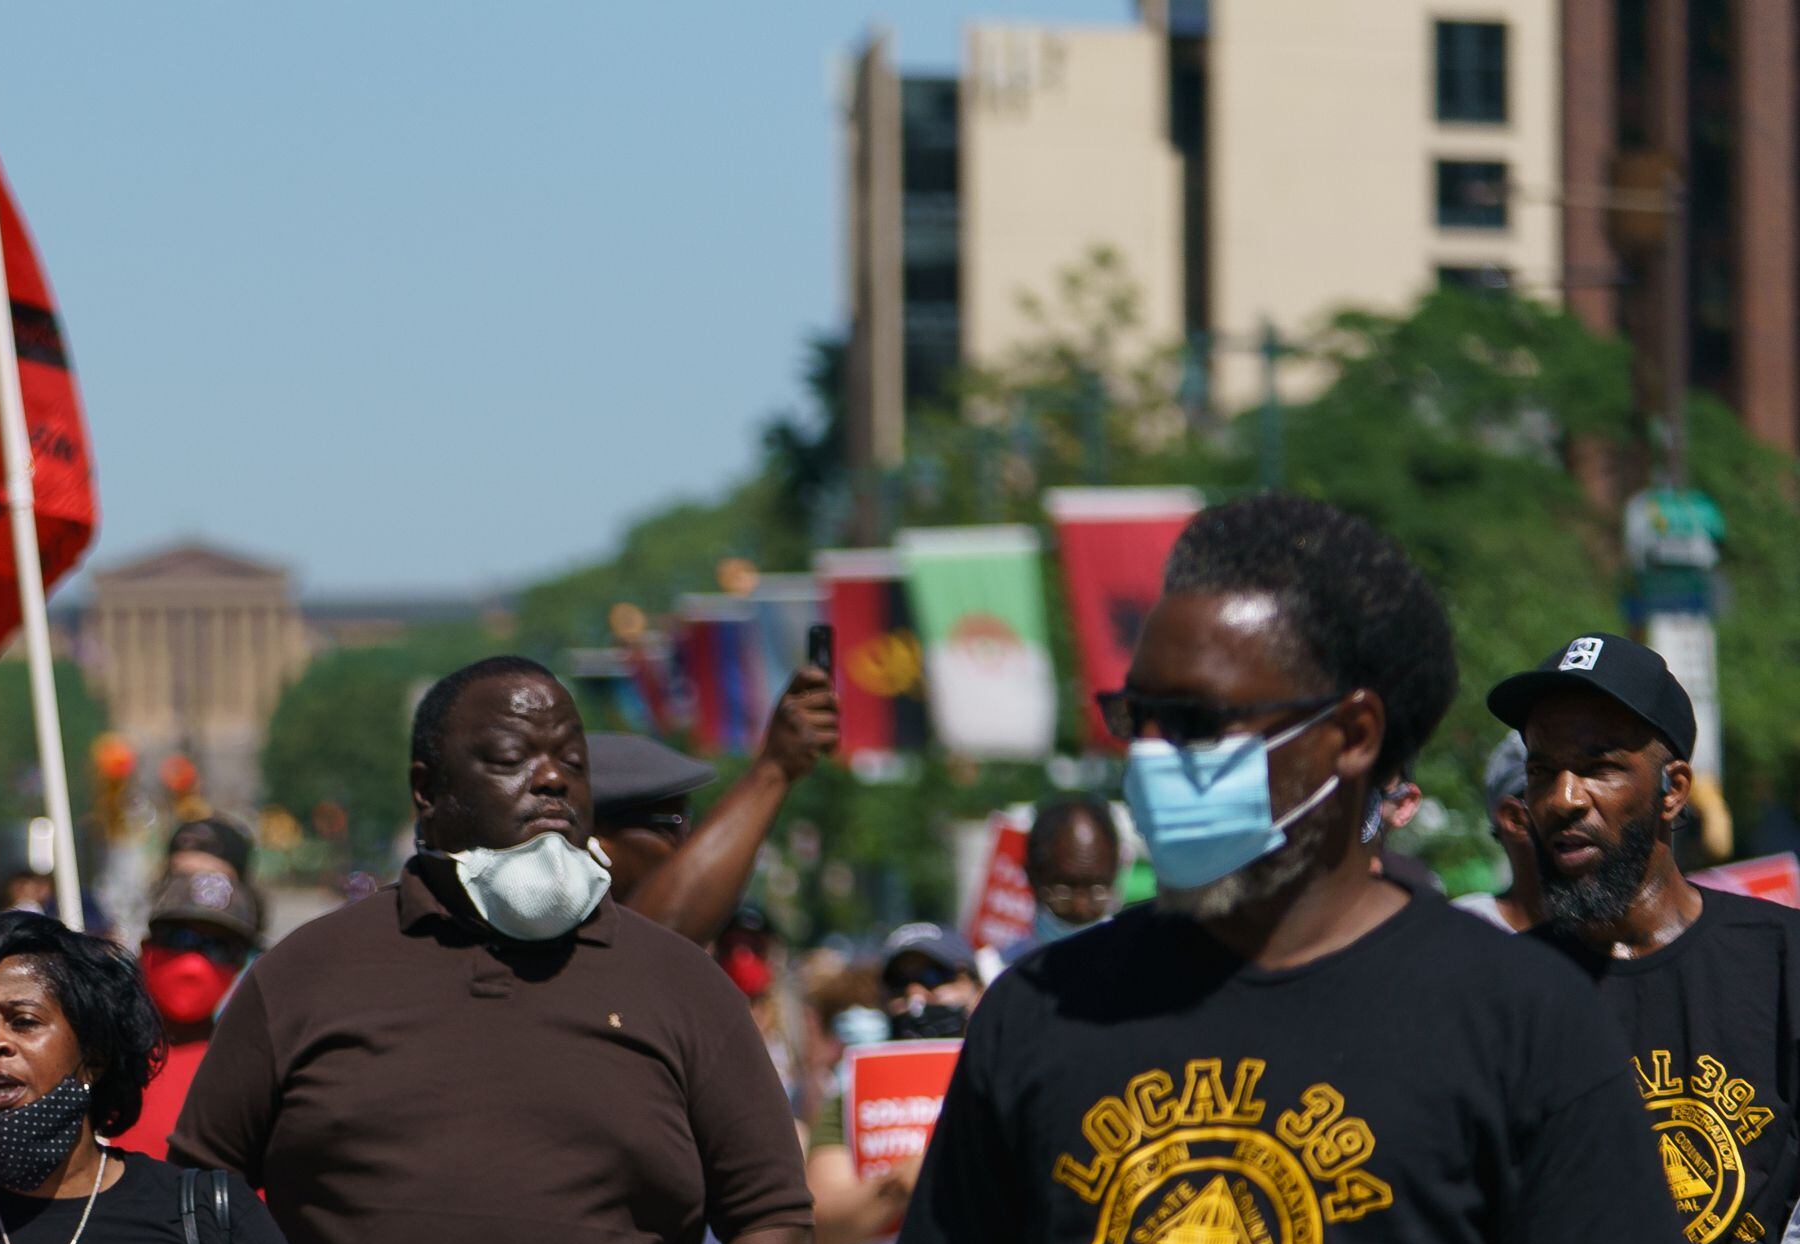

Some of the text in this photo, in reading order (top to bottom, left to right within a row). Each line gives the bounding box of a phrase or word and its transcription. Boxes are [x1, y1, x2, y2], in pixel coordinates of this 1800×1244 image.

[1052, 1056, 1394, 1225] LOCAL 394
[1671, 1103, 1739, 1172] FEDERATION
[1690, 1054, 1776, 1147] 394
[1674, 1130, 1717, 1180] COUNTY
